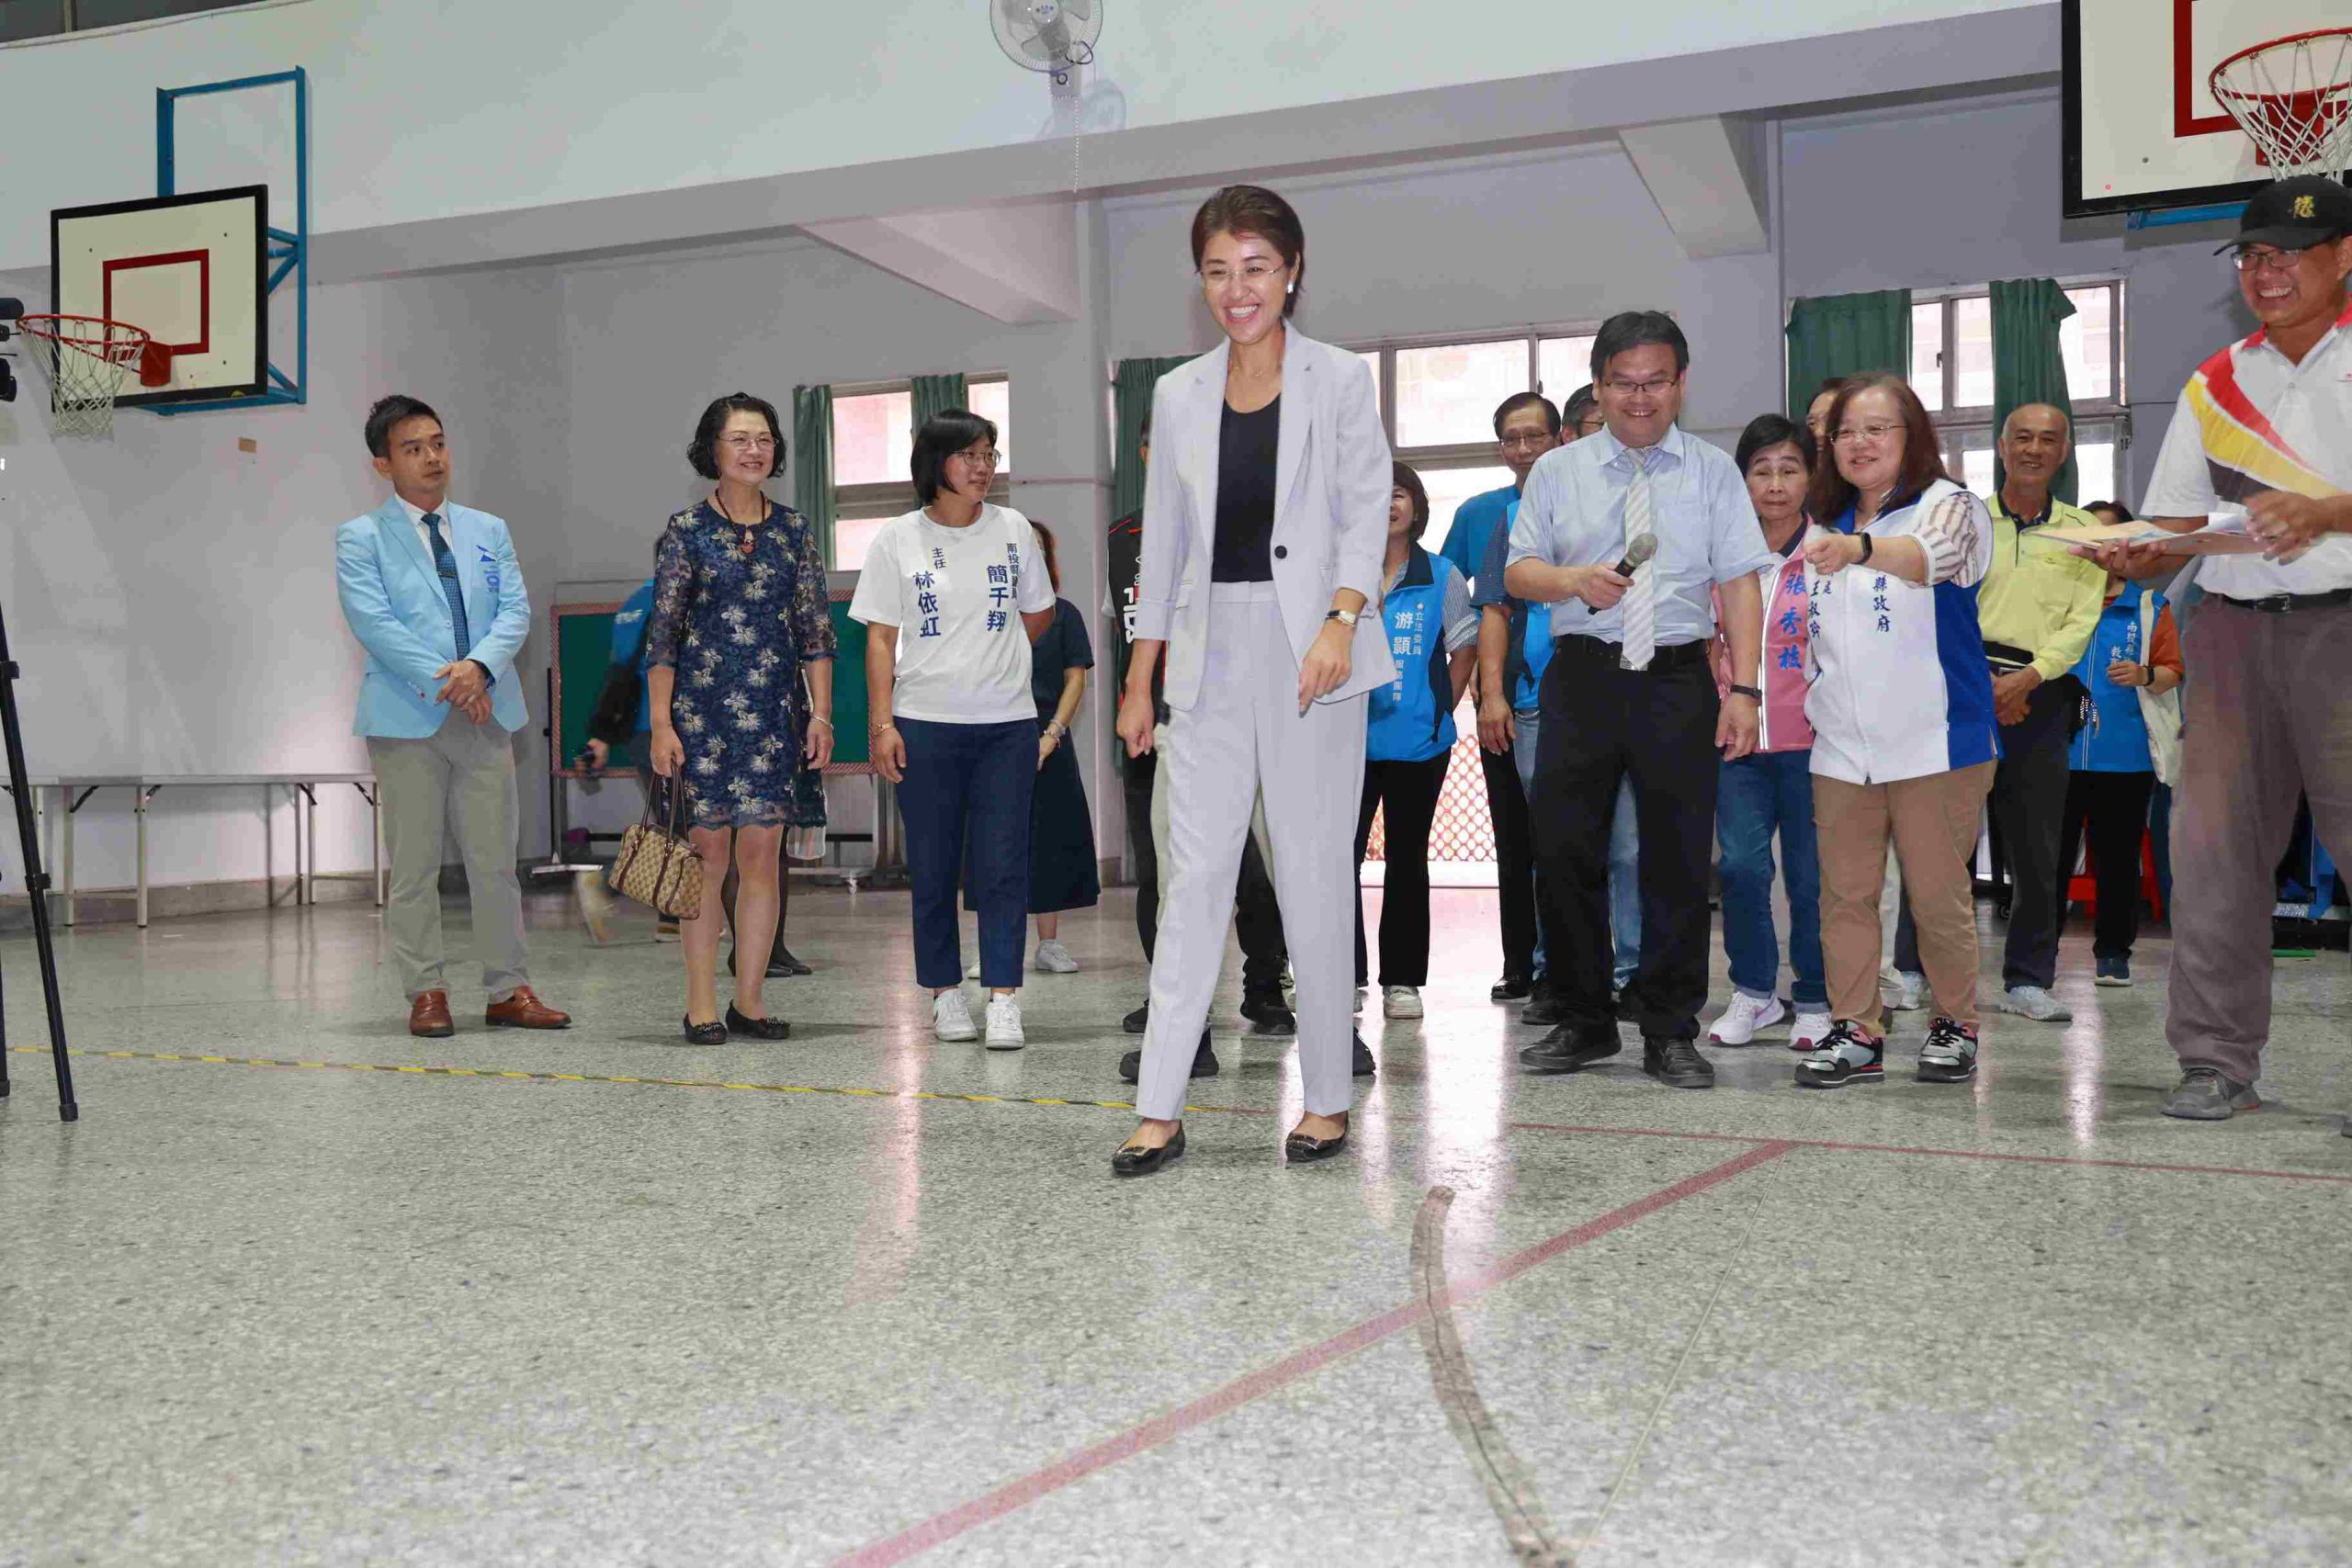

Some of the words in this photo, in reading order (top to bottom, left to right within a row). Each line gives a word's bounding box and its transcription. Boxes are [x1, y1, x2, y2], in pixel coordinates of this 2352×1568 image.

[932, 547, 946, 570] 主任
[912, 570, 941, 637] 林依虹
[986, 564, 1009, 632] 簡千翔
[1778, 573, 1807, 670] 張秀枝
[1872, 574, 1892, 633] 縣政府
